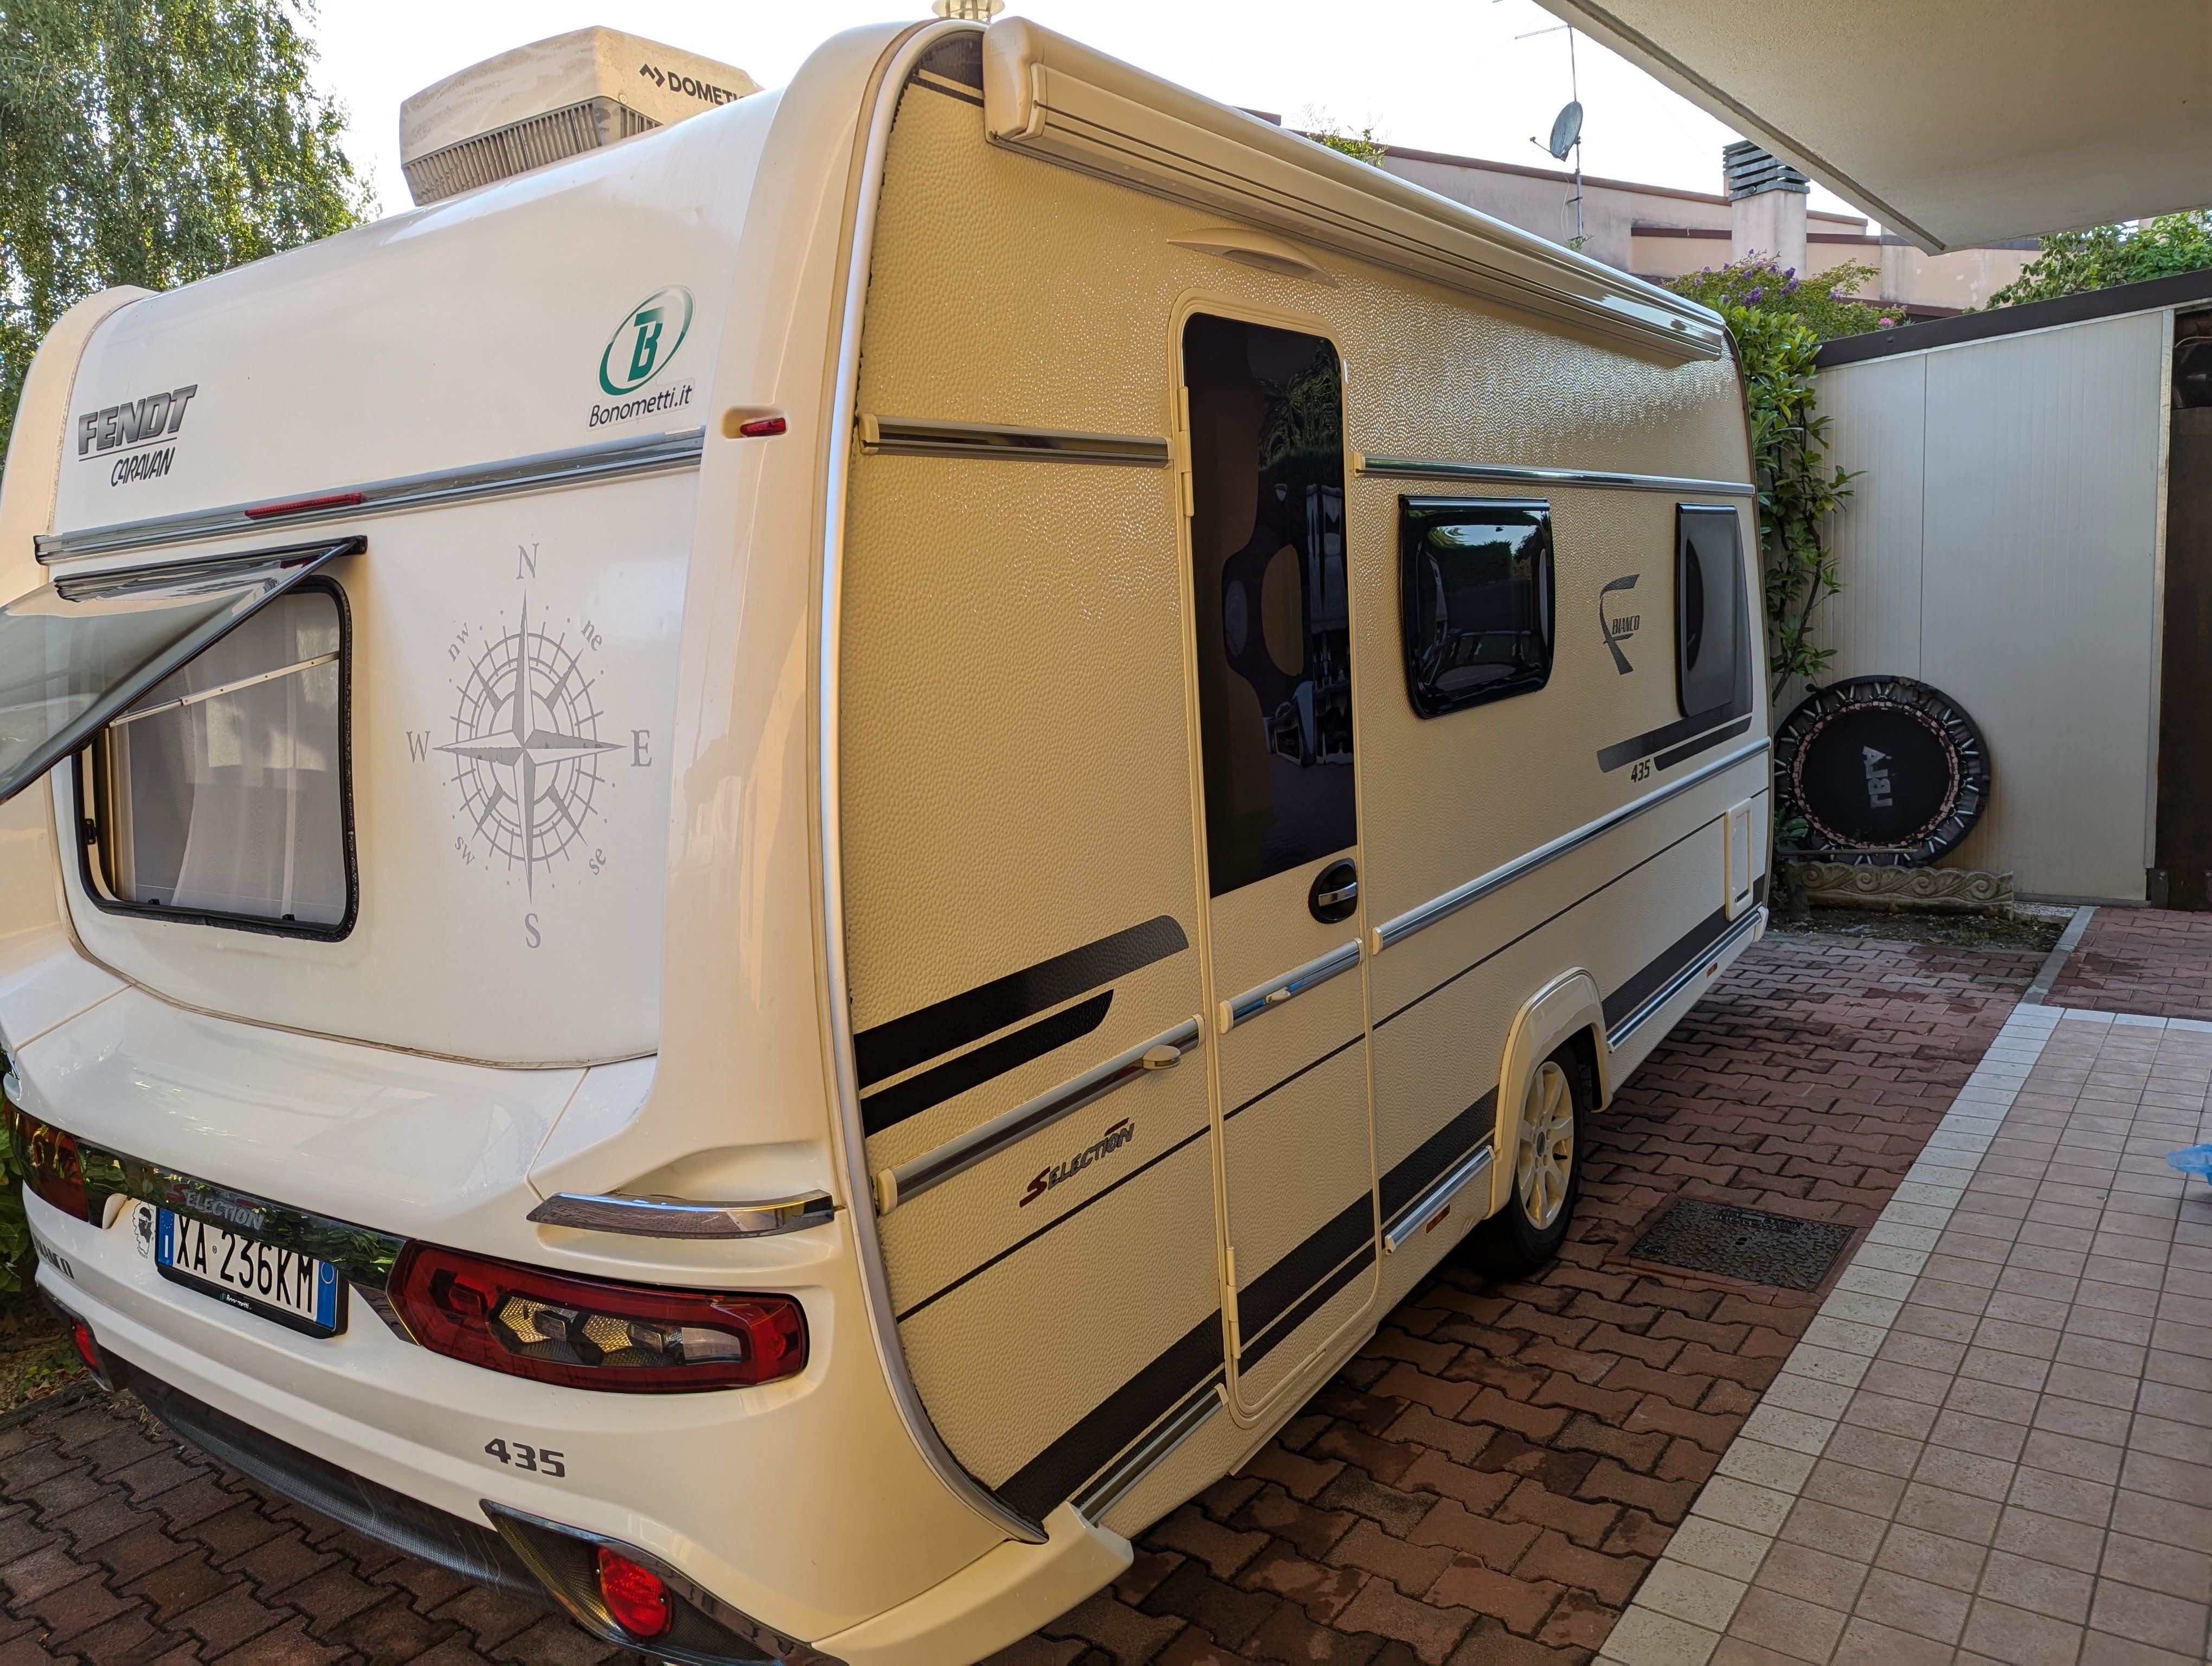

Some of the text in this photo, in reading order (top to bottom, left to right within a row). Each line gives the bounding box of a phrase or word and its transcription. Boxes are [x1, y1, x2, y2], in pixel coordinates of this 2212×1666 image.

[667, 71, 744, 105] DOMET
[78, 384, 198, 456] FENDT
[589, 385, 692, 427] Bonometti.it
[111, 446, 176, 487] CARAVAN
[516, 543, 539, 579] N
[581, 620, 602, 651] ne
[406, 730, 431, 764] W
[631, 729, 652, 767] E
[1631, 758, 1650, 783] 435
[589, 848, 606, 875] se
[525, 913, 542, 949] S
[484, 1438, 565, 1477] 435
